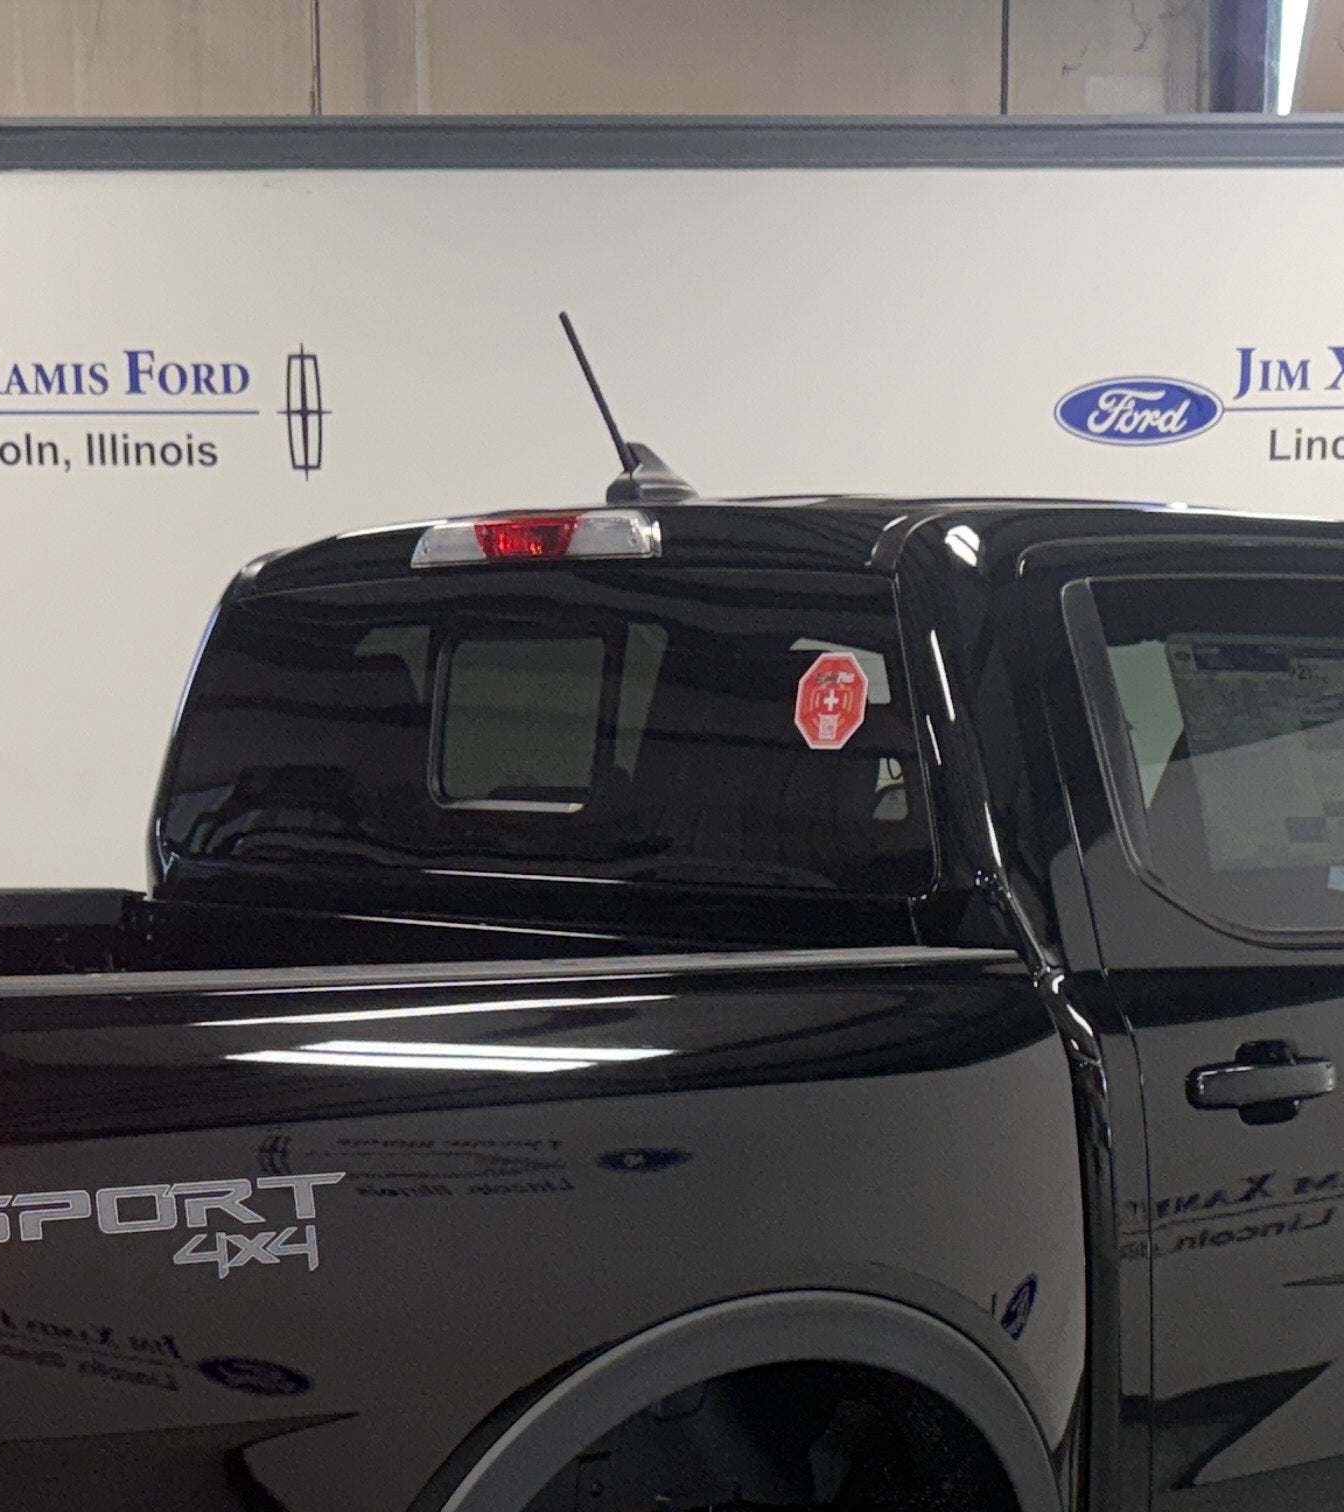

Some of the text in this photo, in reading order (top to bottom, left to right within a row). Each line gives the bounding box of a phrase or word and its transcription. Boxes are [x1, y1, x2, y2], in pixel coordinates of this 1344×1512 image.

[123, 349, 250, 397] FORD
[1232, 346, 1311, 401] JIM
[1086, 388, 1188, 435] Ford
[86, 432, 219, 467] Illinois
